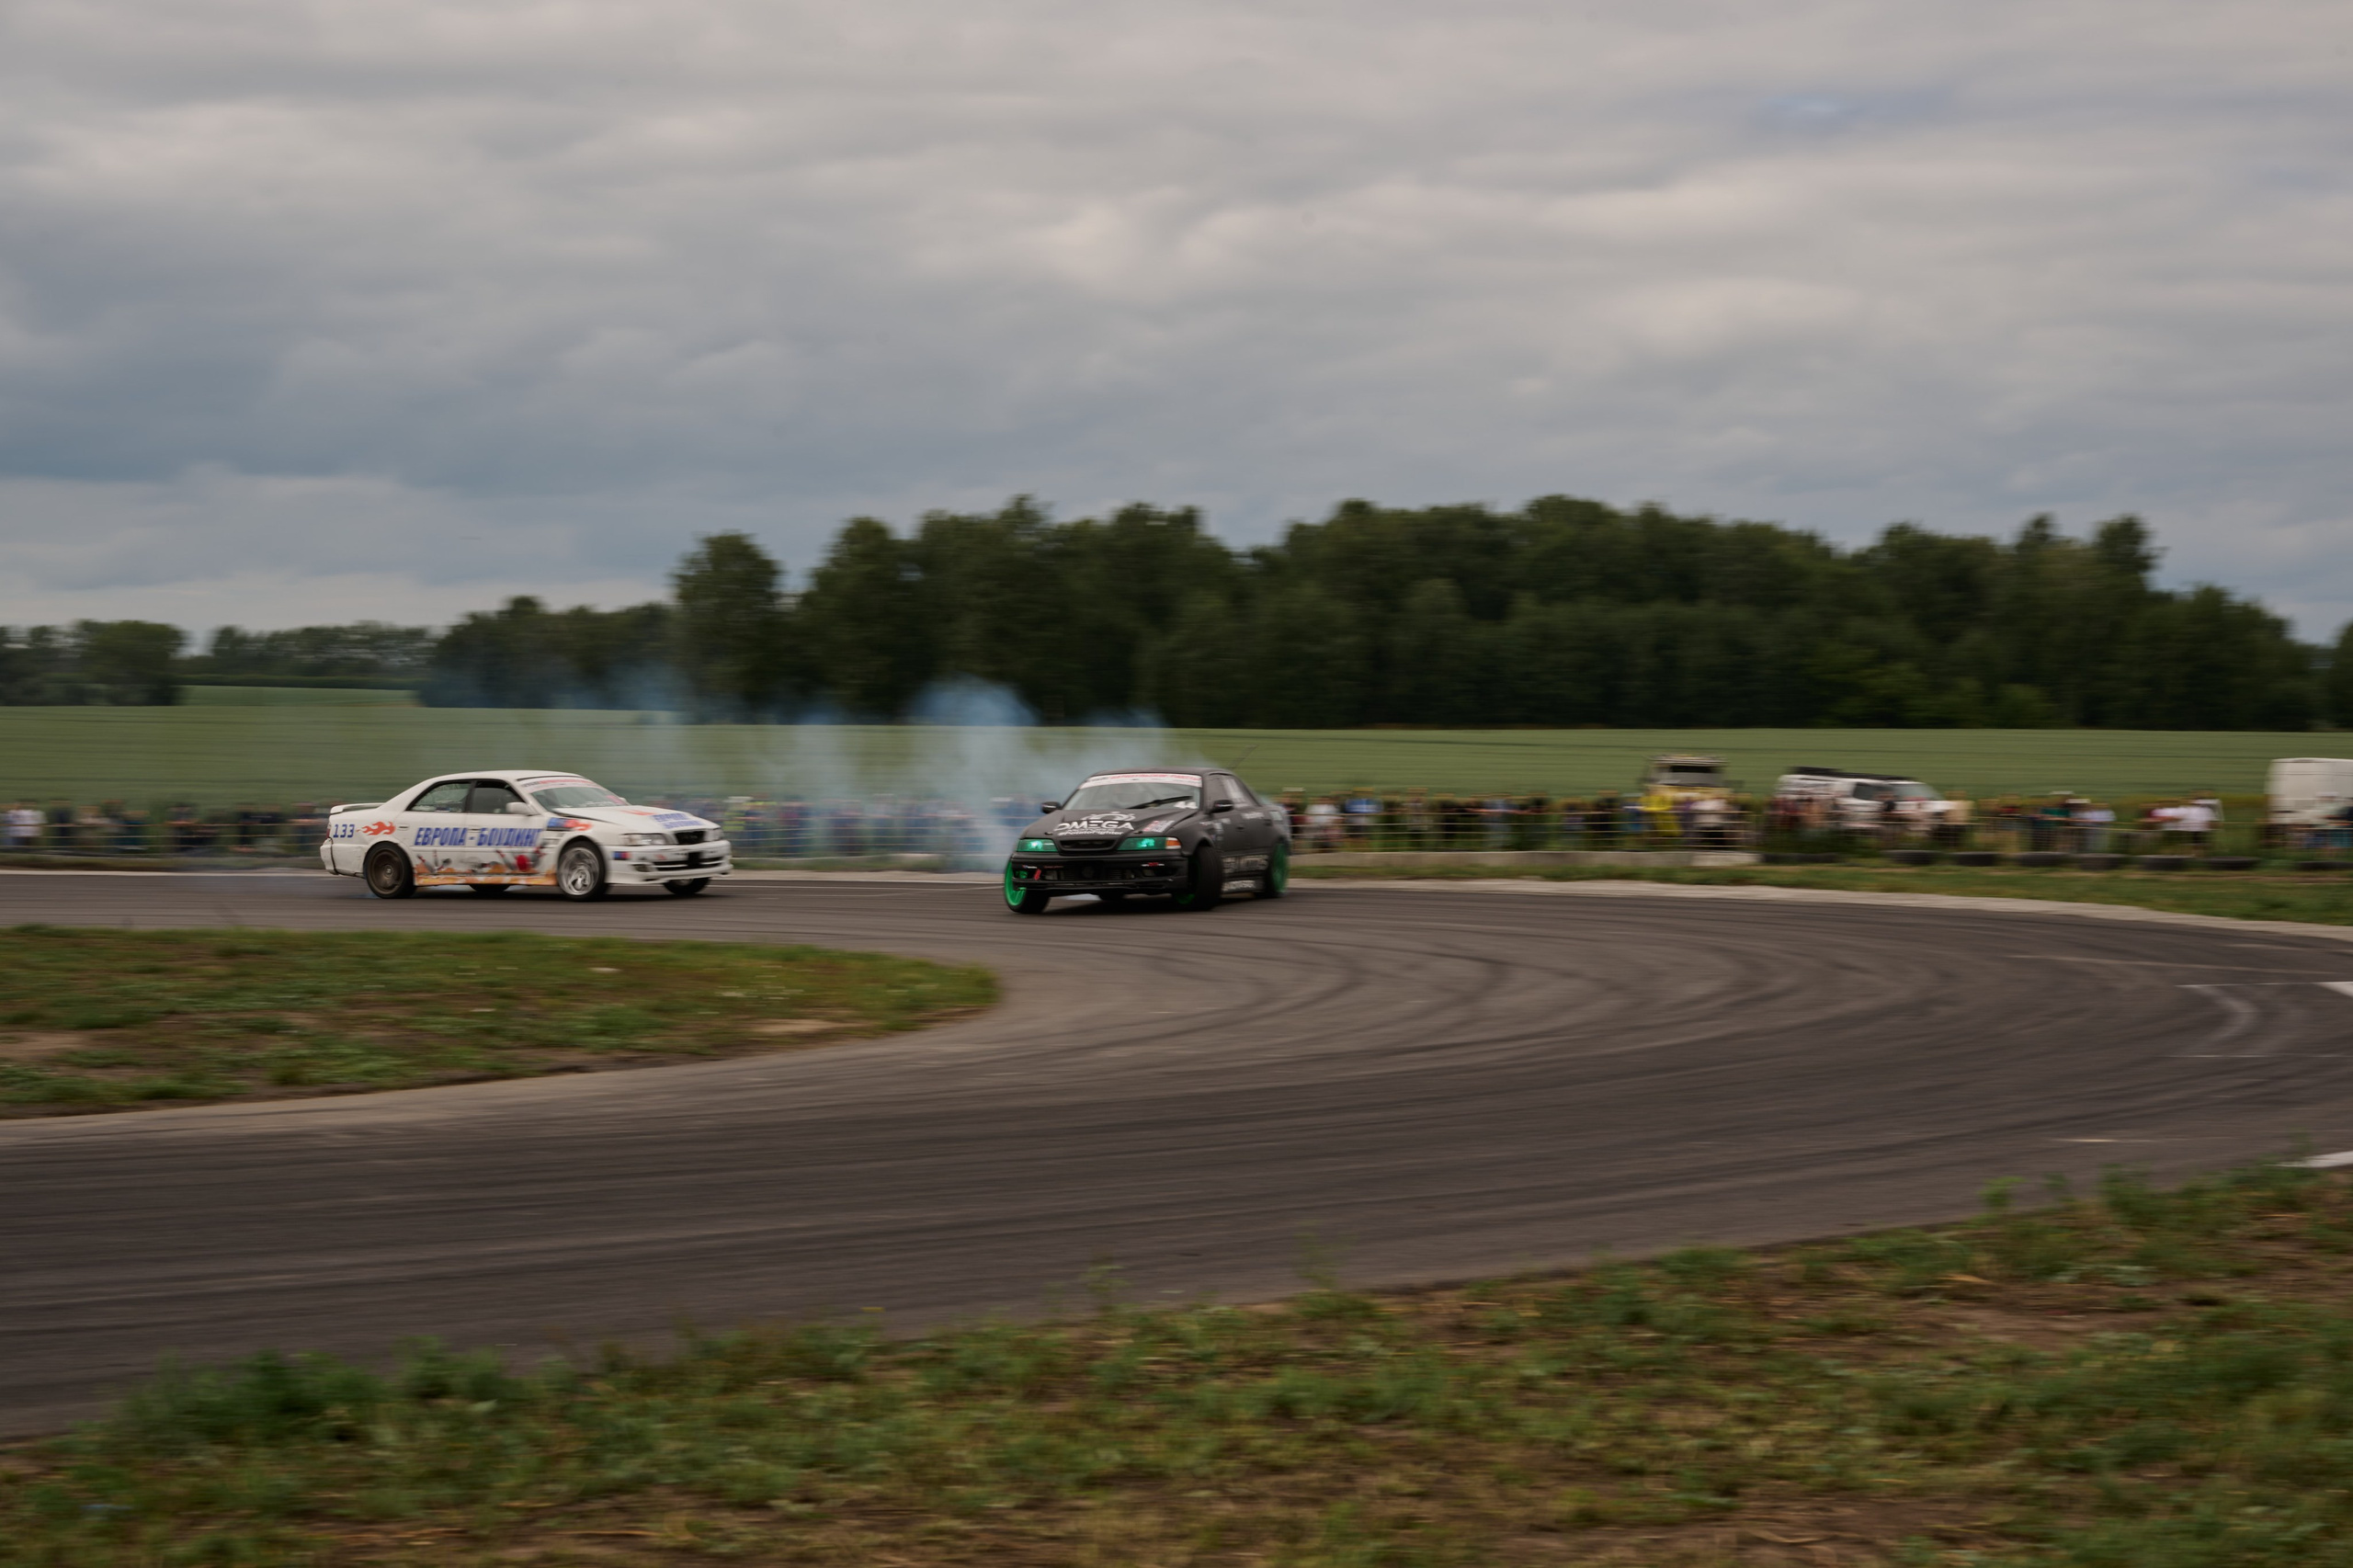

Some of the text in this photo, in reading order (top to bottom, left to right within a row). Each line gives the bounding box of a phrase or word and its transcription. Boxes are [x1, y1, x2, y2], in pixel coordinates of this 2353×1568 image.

[333, 824, 355, 838] 133
[1053, 820, 1134, 832] OMEGA
[414, 827, 467, 846] ЕВРОПА
